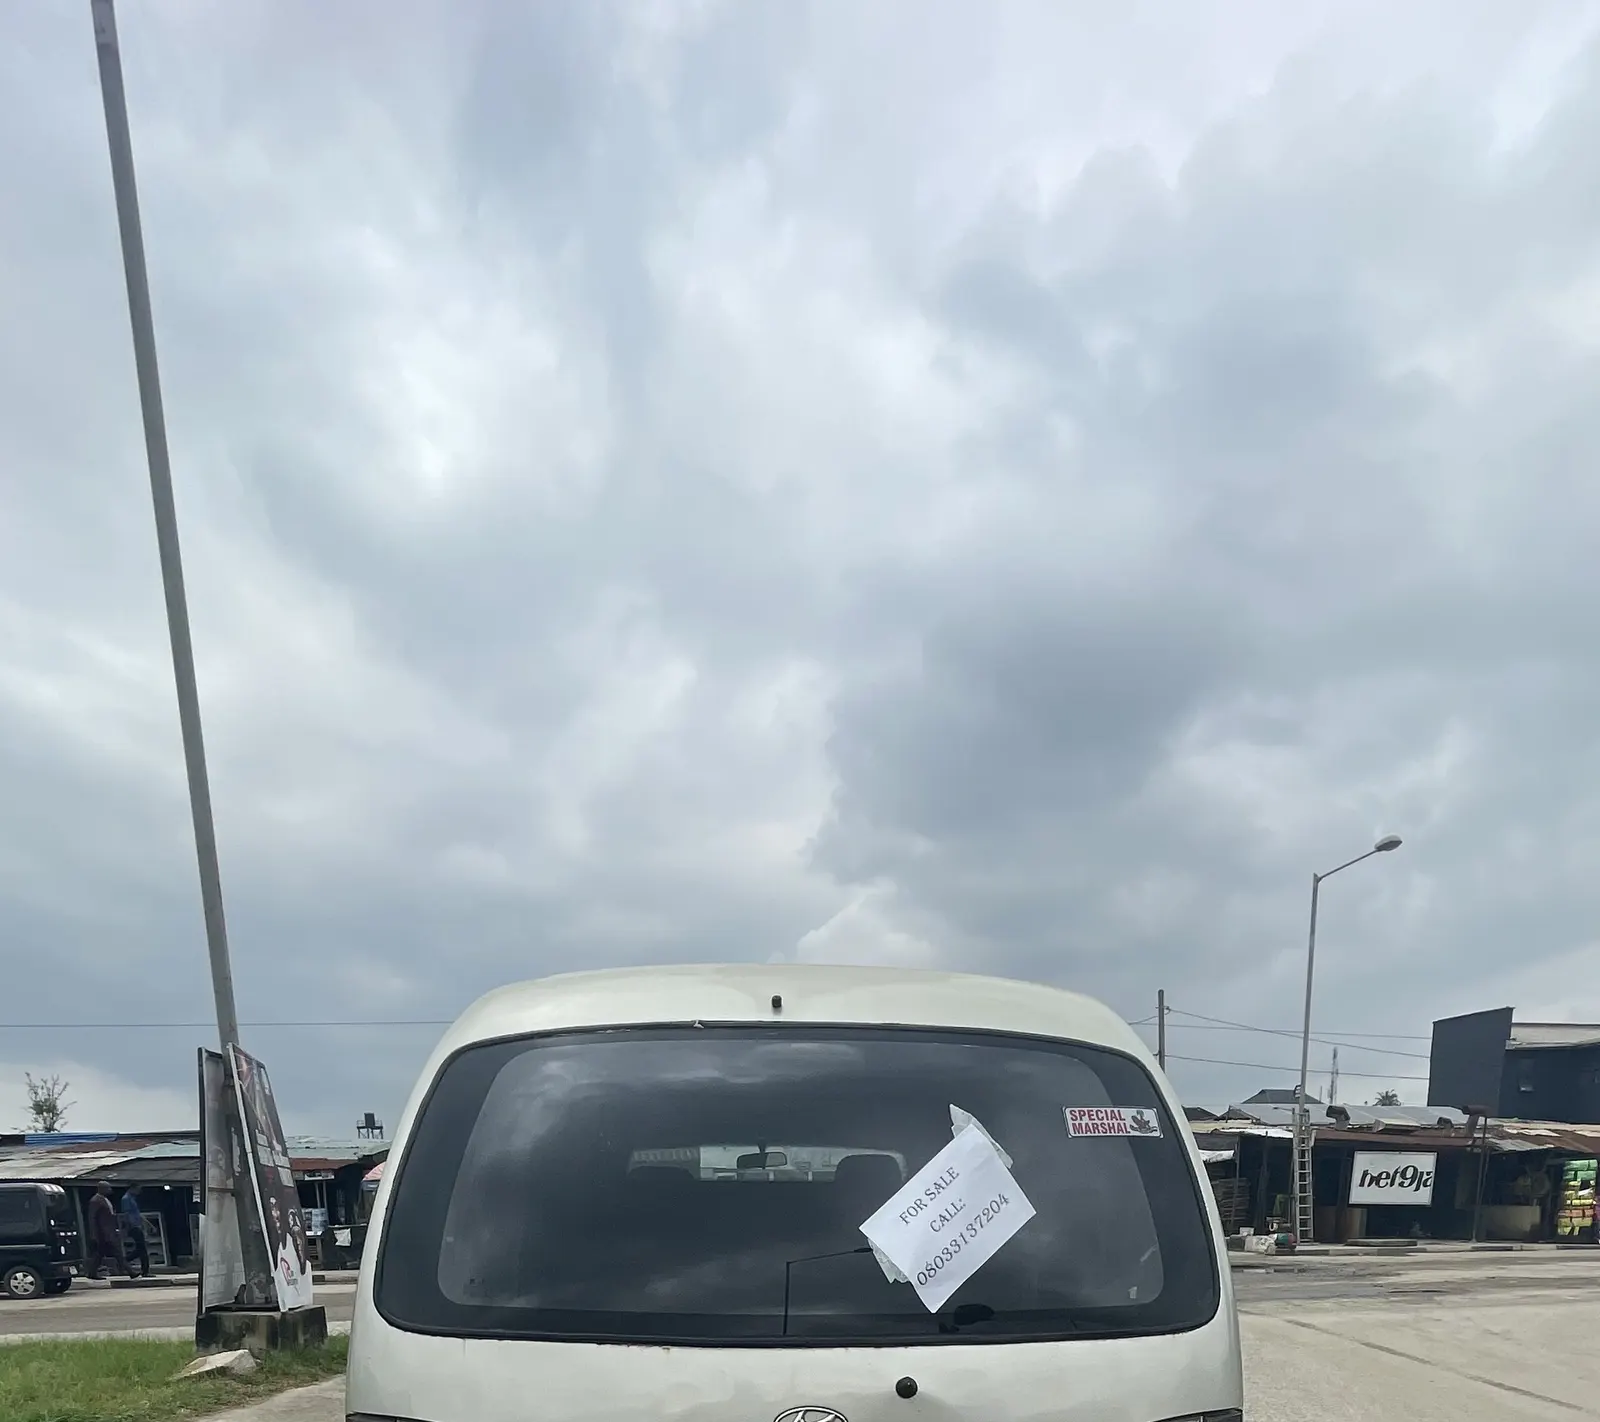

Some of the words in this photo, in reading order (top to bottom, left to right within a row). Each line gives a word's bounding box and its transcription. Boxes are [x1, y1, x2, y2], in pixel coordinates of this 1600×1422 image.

[1070, 1110, 1126, 1121] SPECIAL
[1072, 1123, 1131, 1134] MARSHAL
[899, 1198, 928, 1226] FOR
[924, 1166, 960, 1201] SALE
[929, 1198, 967, 1233] CALL:
[916, 1193, 1009, 1286] 08033137204
